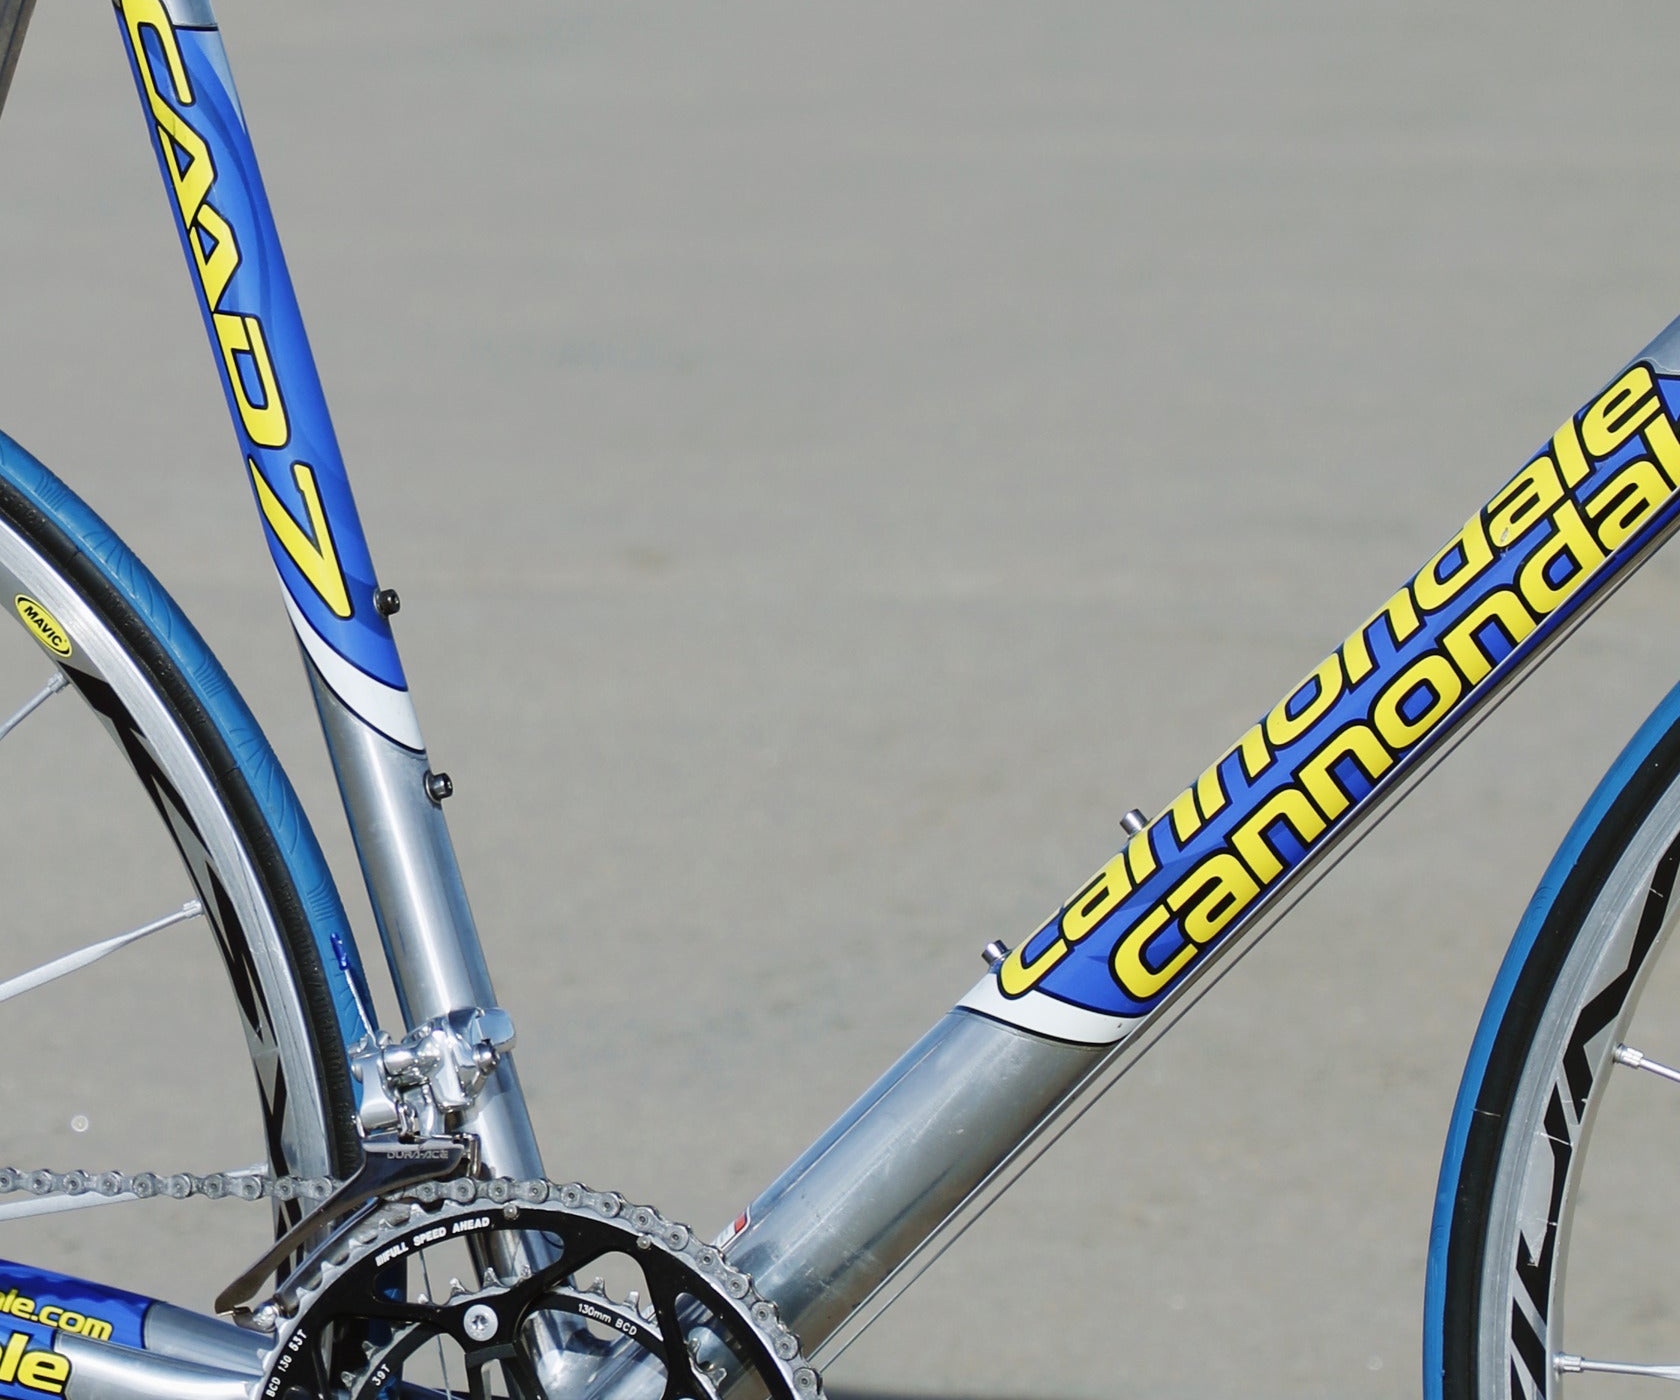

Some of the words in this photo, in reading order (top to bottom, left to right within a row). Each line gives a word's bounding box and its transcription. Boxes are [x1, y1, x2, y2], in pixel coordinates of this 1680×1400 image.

[23, 604, 64, 648] MAVIC
[998, 363, 1662, 999] cannondale
[1109, 413, 1680, 1001] cannondal
[386, 1150, 449, 1160] DURA-ACE
[384, 1243, 410, 1263] FULL
[413, 1227, 447, 1247] SPEED
[452, 1217, 491, 1234] AHEAD
[578, 1303, 613, 1324] 130mm
[614, 1318, 639, 1337] BCD
[265, 1376, 281, 1398] BCD
[277, 1354, 293, 1373] 130
[371, 1363, 391, 1387] 39T
